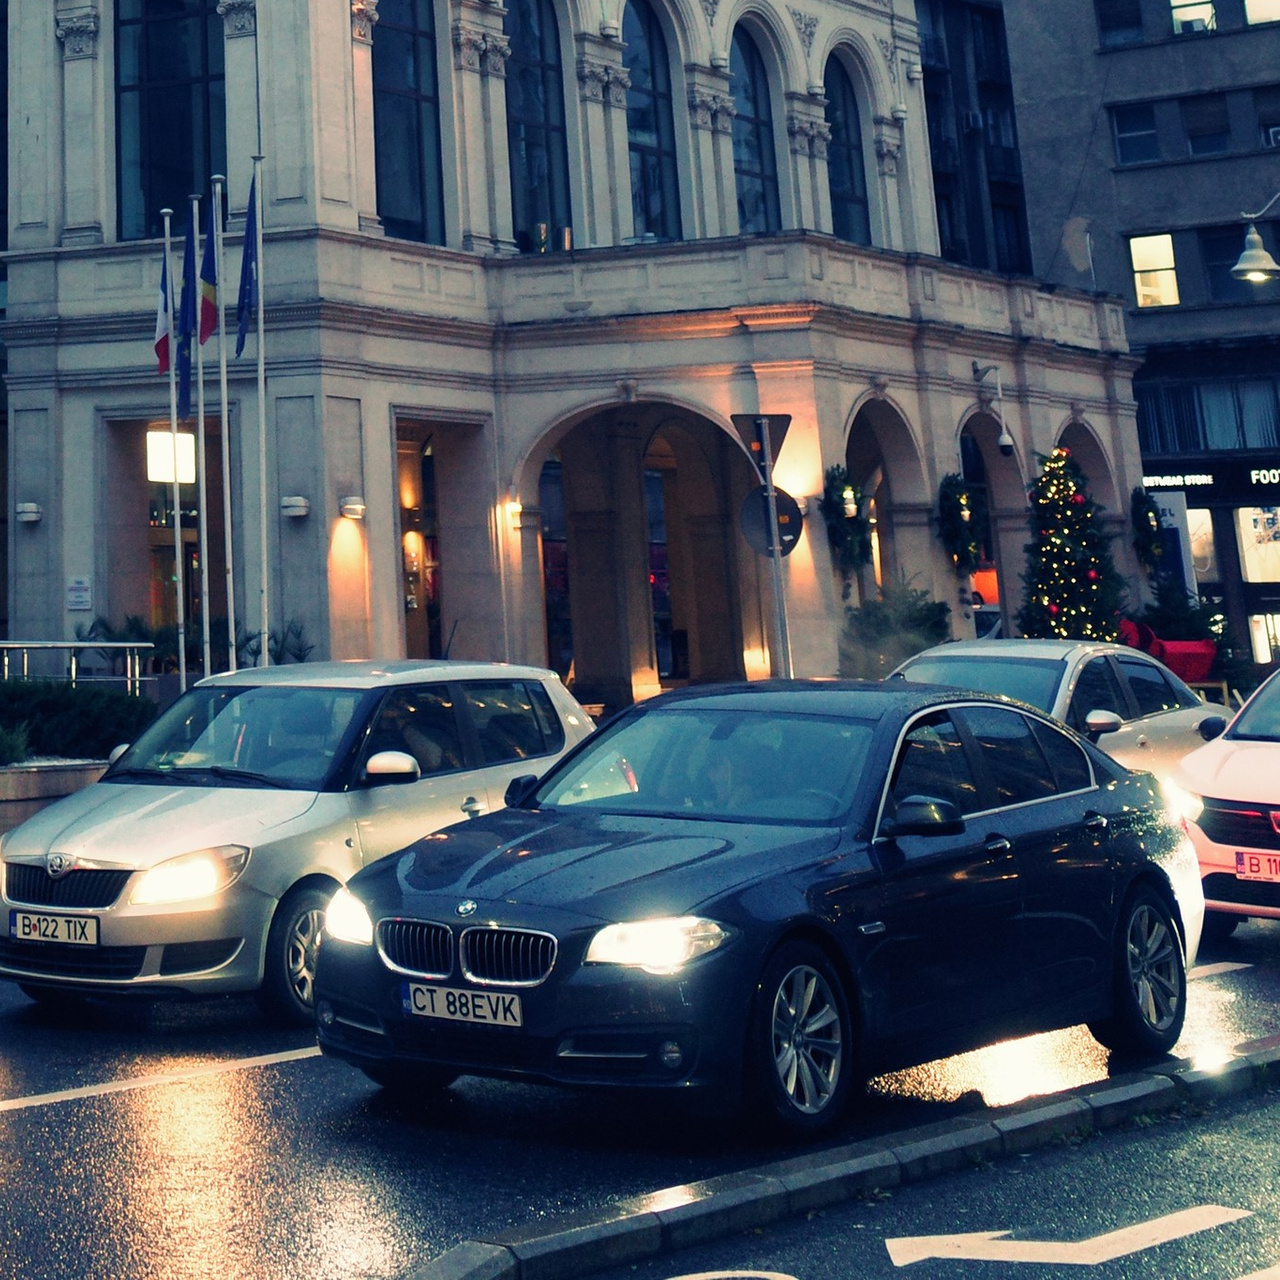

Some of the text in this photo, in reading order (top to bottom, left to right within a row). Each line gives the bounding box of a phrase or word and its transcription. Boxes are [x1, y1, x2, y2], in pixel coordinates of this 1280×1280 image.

[1184, 474, 1214, 486] STORE
[1249, 856, 1261, 873] B
[1267, 857, 1280, 876] 11
[22, 916, 32, 936] B
[36, 917, 59, 939] 122
[64, 919, 89, 942] TIX
[412, 987, 518, 1023] CT 88EVK
